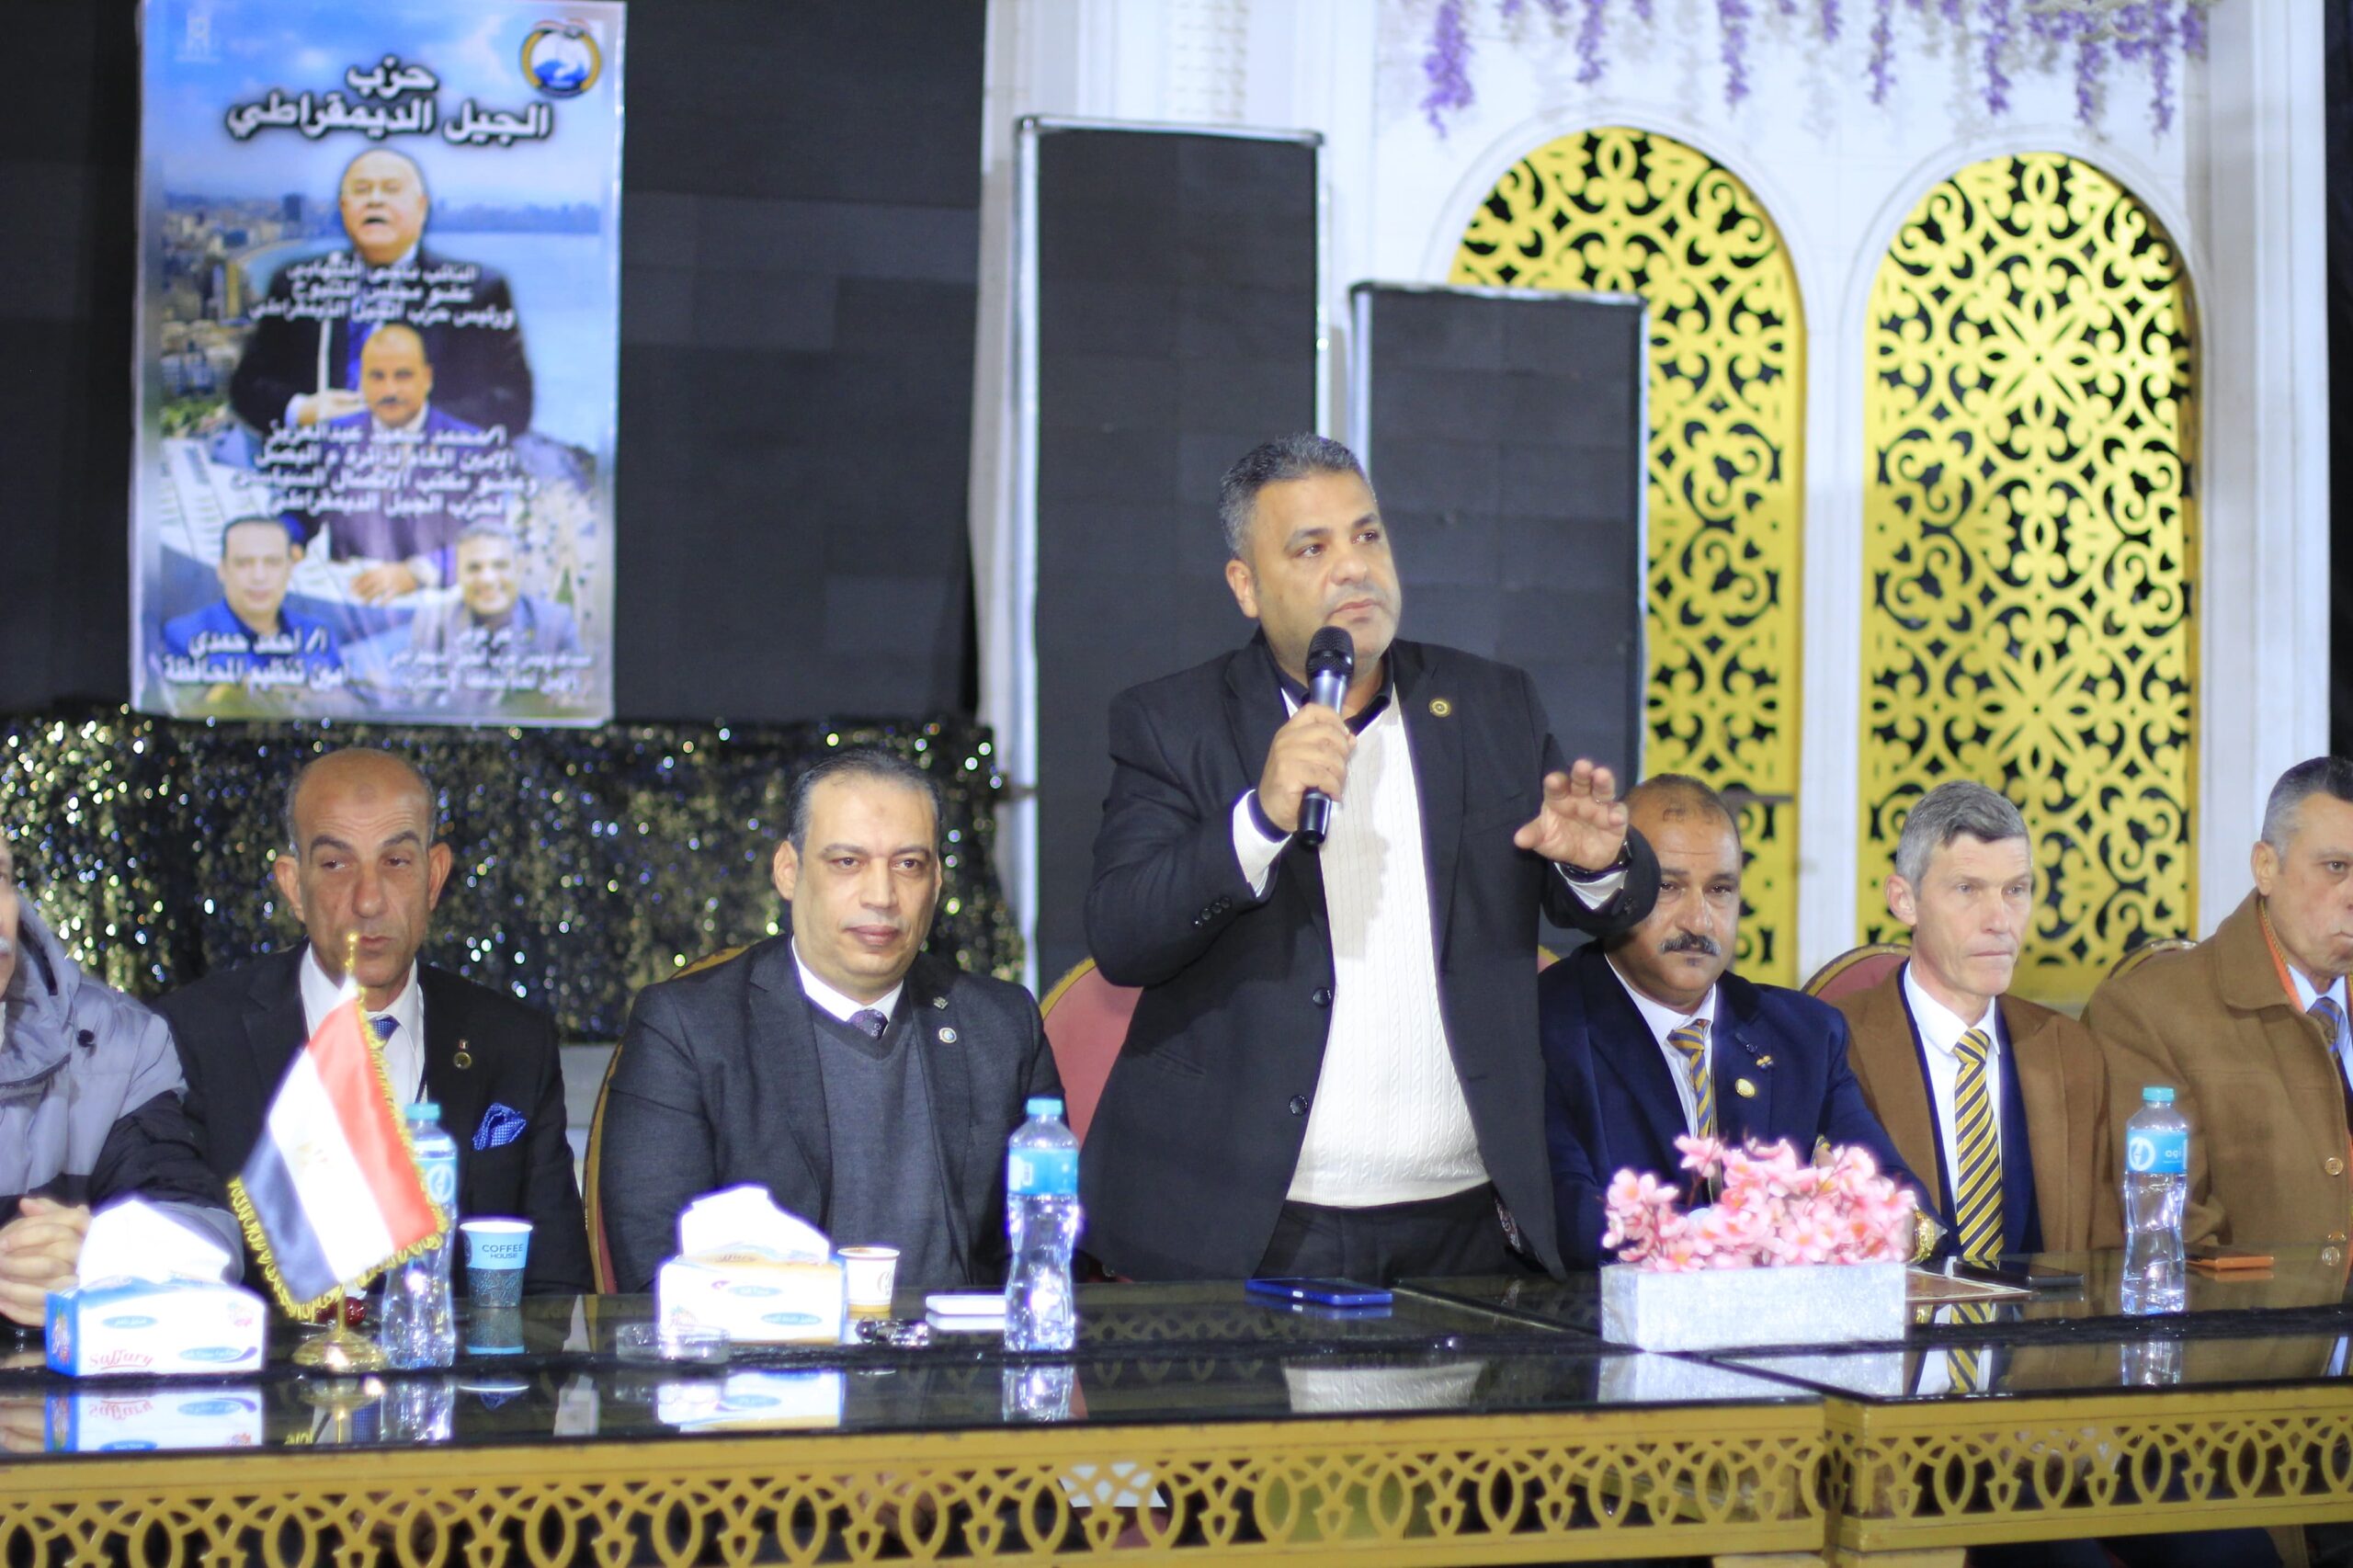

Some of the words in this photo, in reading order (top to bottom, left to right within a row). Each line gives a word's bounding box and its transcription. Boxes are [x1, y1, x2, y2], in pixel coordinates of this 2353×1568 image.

[347, 55, 437, 97] حزب
[226, 91, 435, 140] الديمقراطي
[444, 101, 552, 143] الجيل
[482, 1243, 524, 1253] COFFEE
